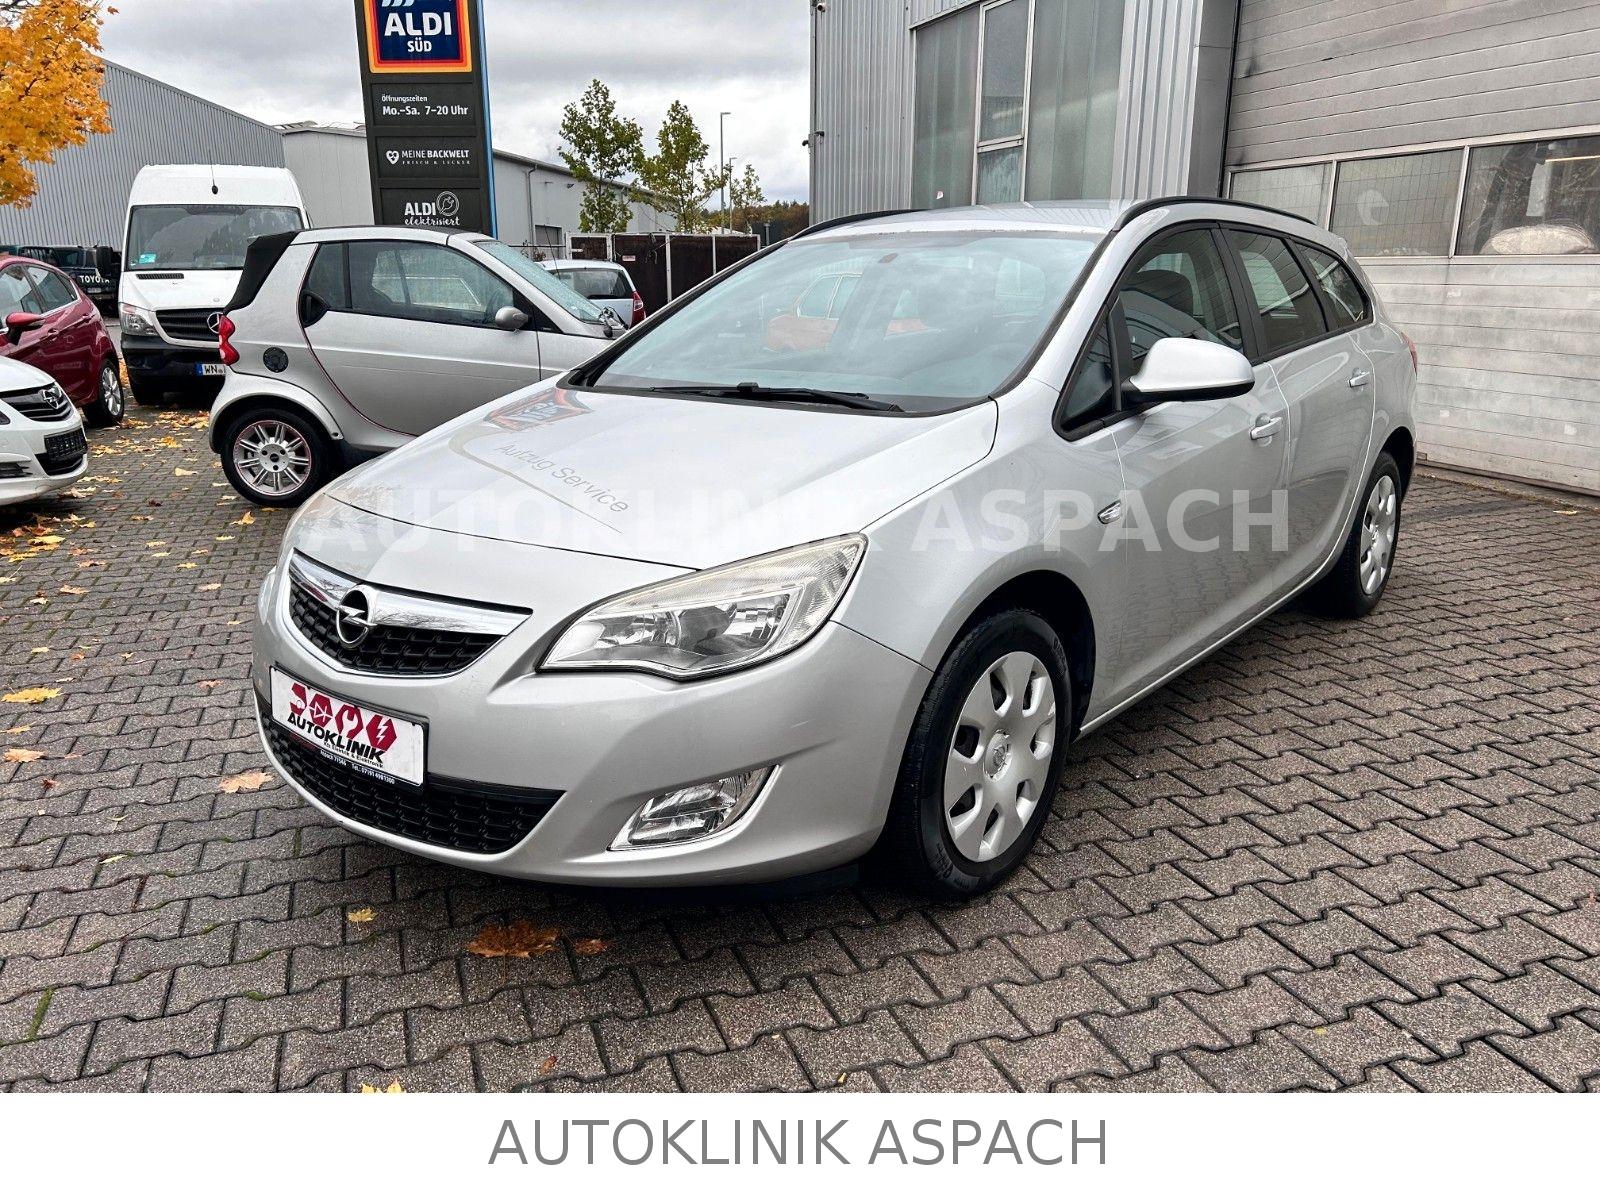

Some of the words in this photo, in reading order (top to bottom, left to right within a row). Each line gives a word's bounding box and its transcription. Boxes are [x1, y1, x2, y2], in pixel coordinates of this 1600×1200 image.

[384, 12, 452, 37] ALDI
[407, 37, 432, 53] SÜD
[381, 94, 428, 104] Öffnungszeiten
[451, 104, 469, 115] Uhr
[401, 150, 427, 158] MEINE
[427, 150, 470, 158] BACKWELT
[404, 202, 437, 216] ALDI
[552, 466, 629, 512] Service
[287, 712, 386, 764] AUTOKLINIK
